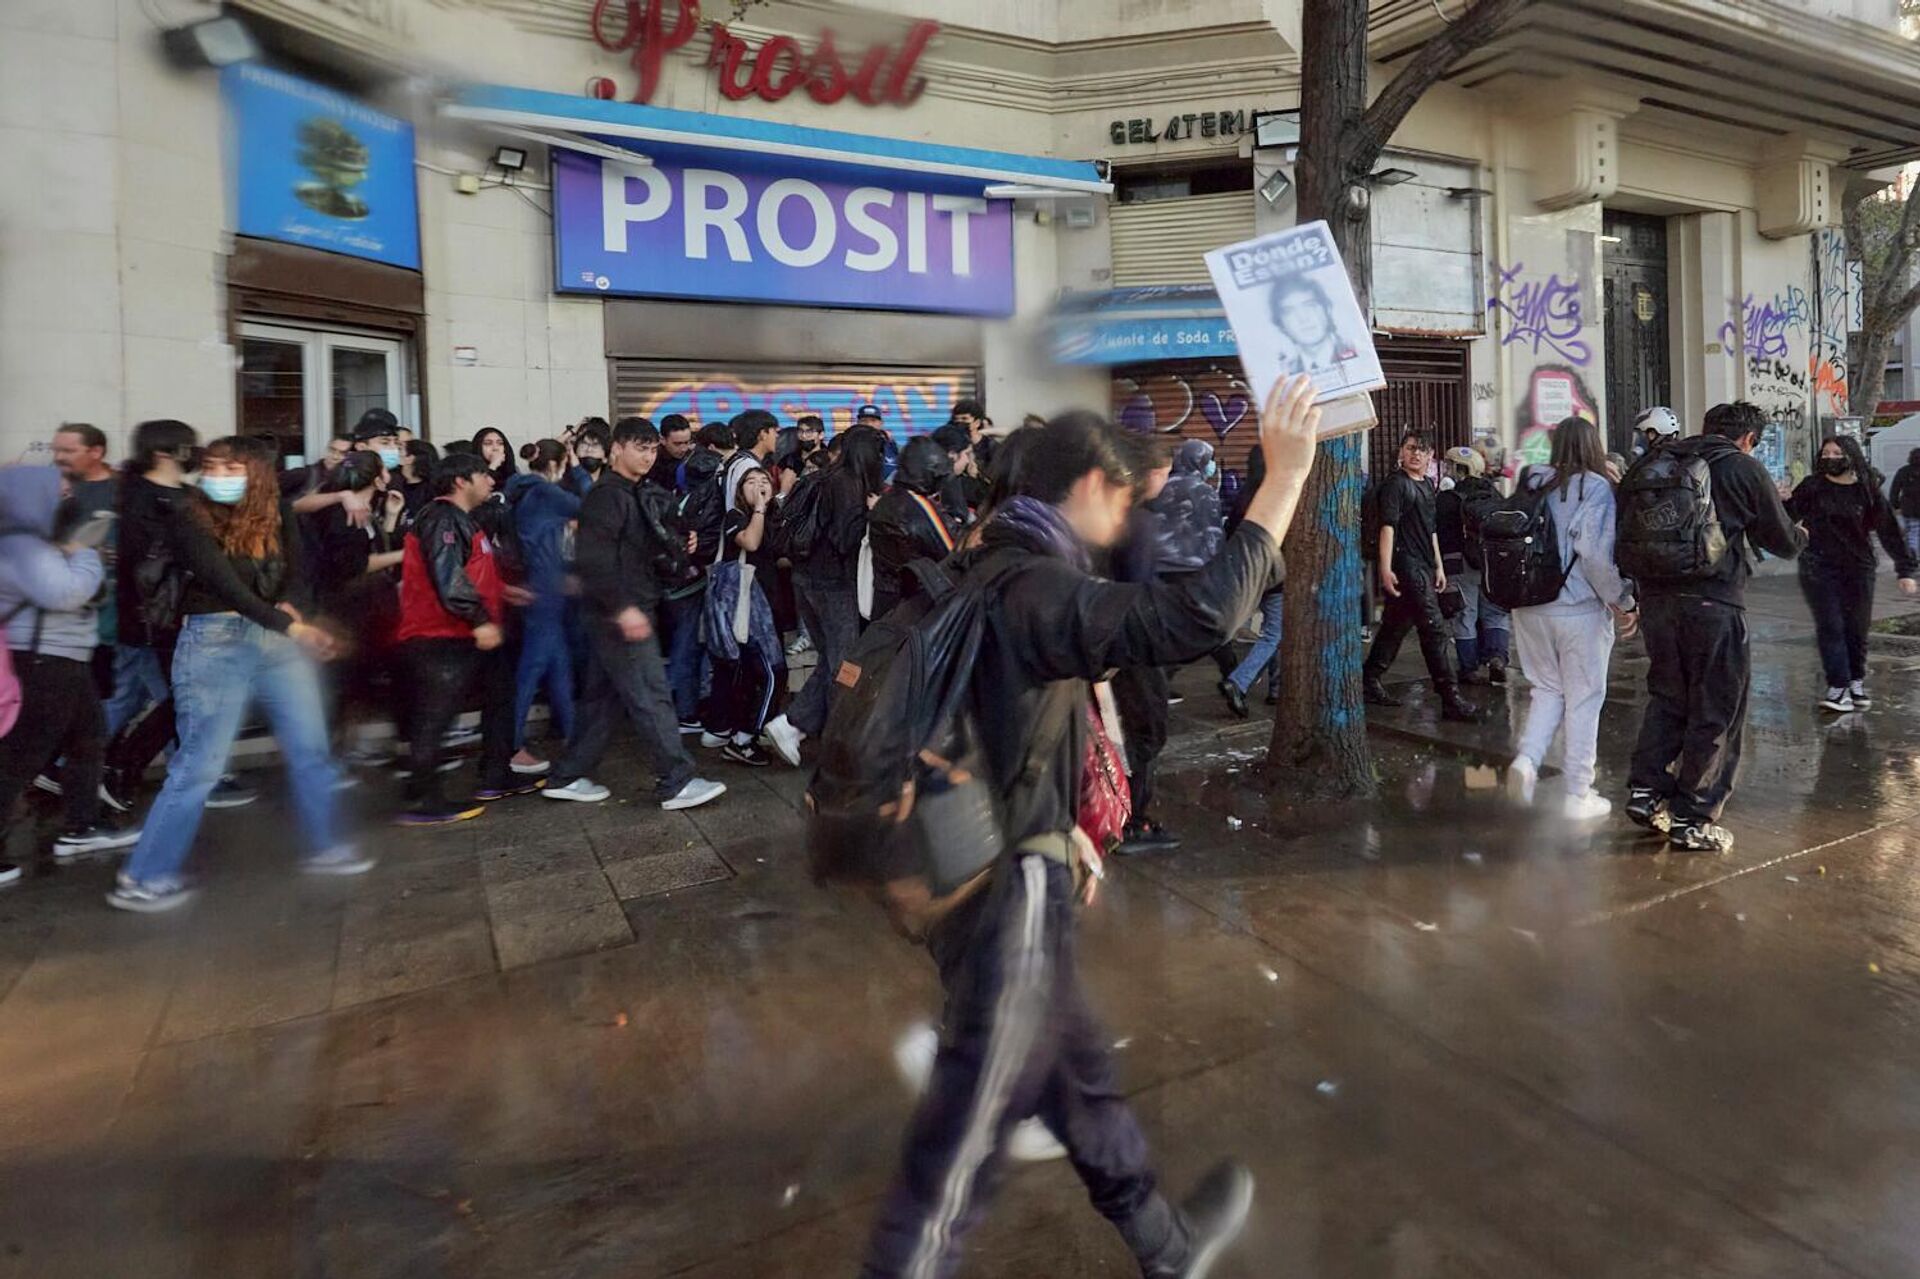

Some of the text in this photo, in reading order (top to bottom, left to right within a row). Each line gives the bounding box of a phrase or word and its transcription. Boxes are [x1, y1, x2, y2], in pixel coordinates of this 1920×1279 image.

[601, 159, 988, 276] PROSIT
[1152, 330, 1169, 345] de
[1177, 330, 1210, 344] Soda
